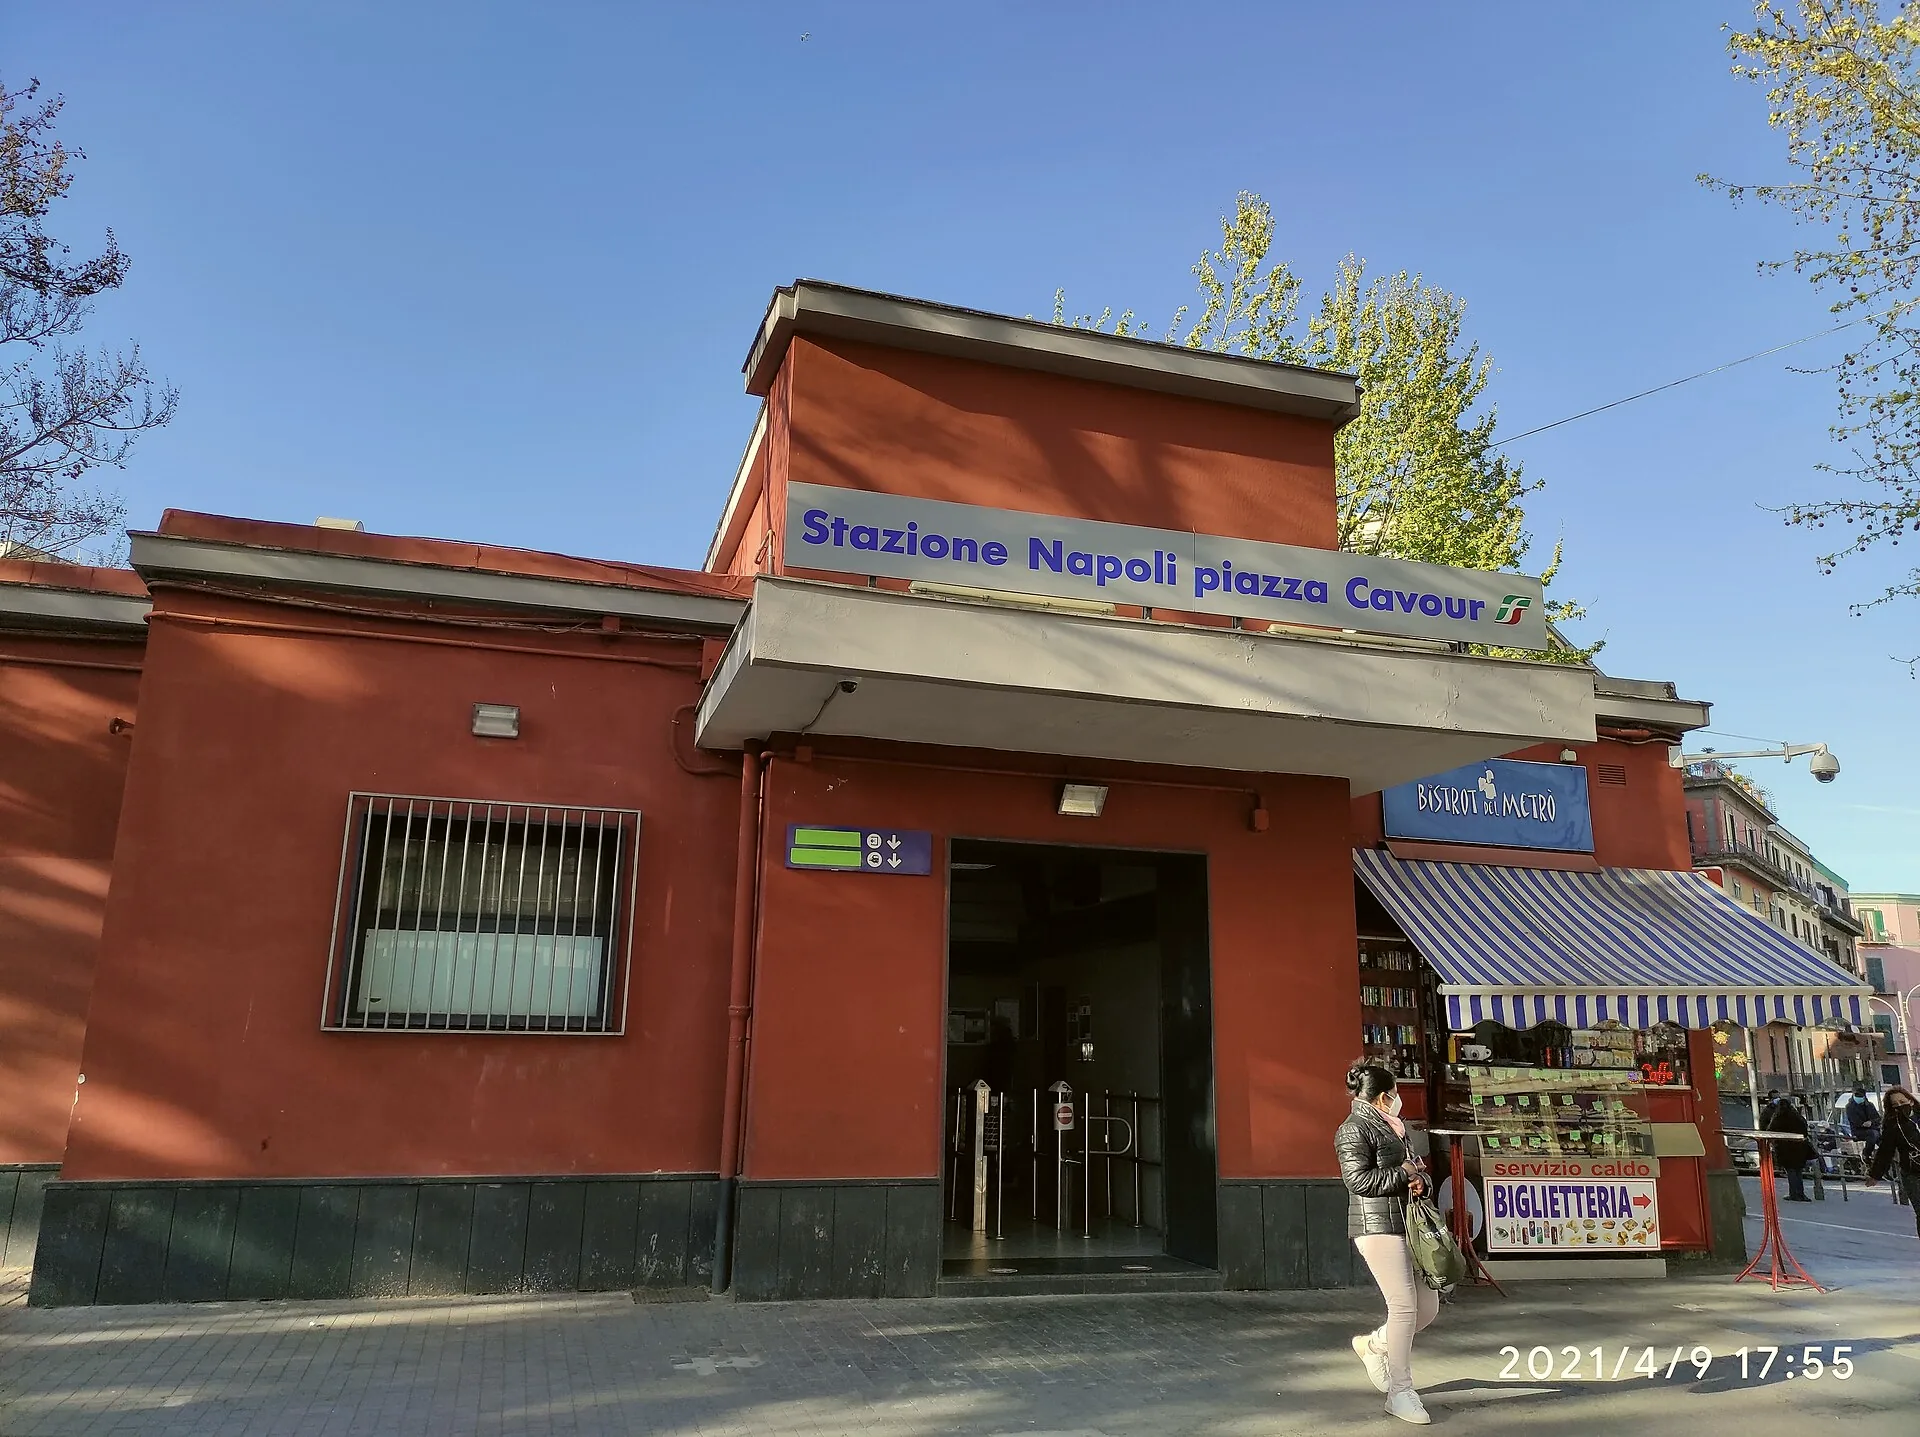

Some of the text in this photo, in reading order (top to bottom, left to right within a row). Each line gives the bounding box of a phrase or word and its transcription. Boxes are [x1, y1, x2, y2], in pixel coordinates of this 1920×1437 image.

[801, 509, 1486, 622] Stazione Napoli piazza Cavour
[1483, 800, 1500, 817] DEL
[1502, 788, 1557, 823] METRÒ
[1494, 1160, 1650, 1177] servizio caldo
[1493, 1185, 1633, 1219] BIGLIETTERIA
